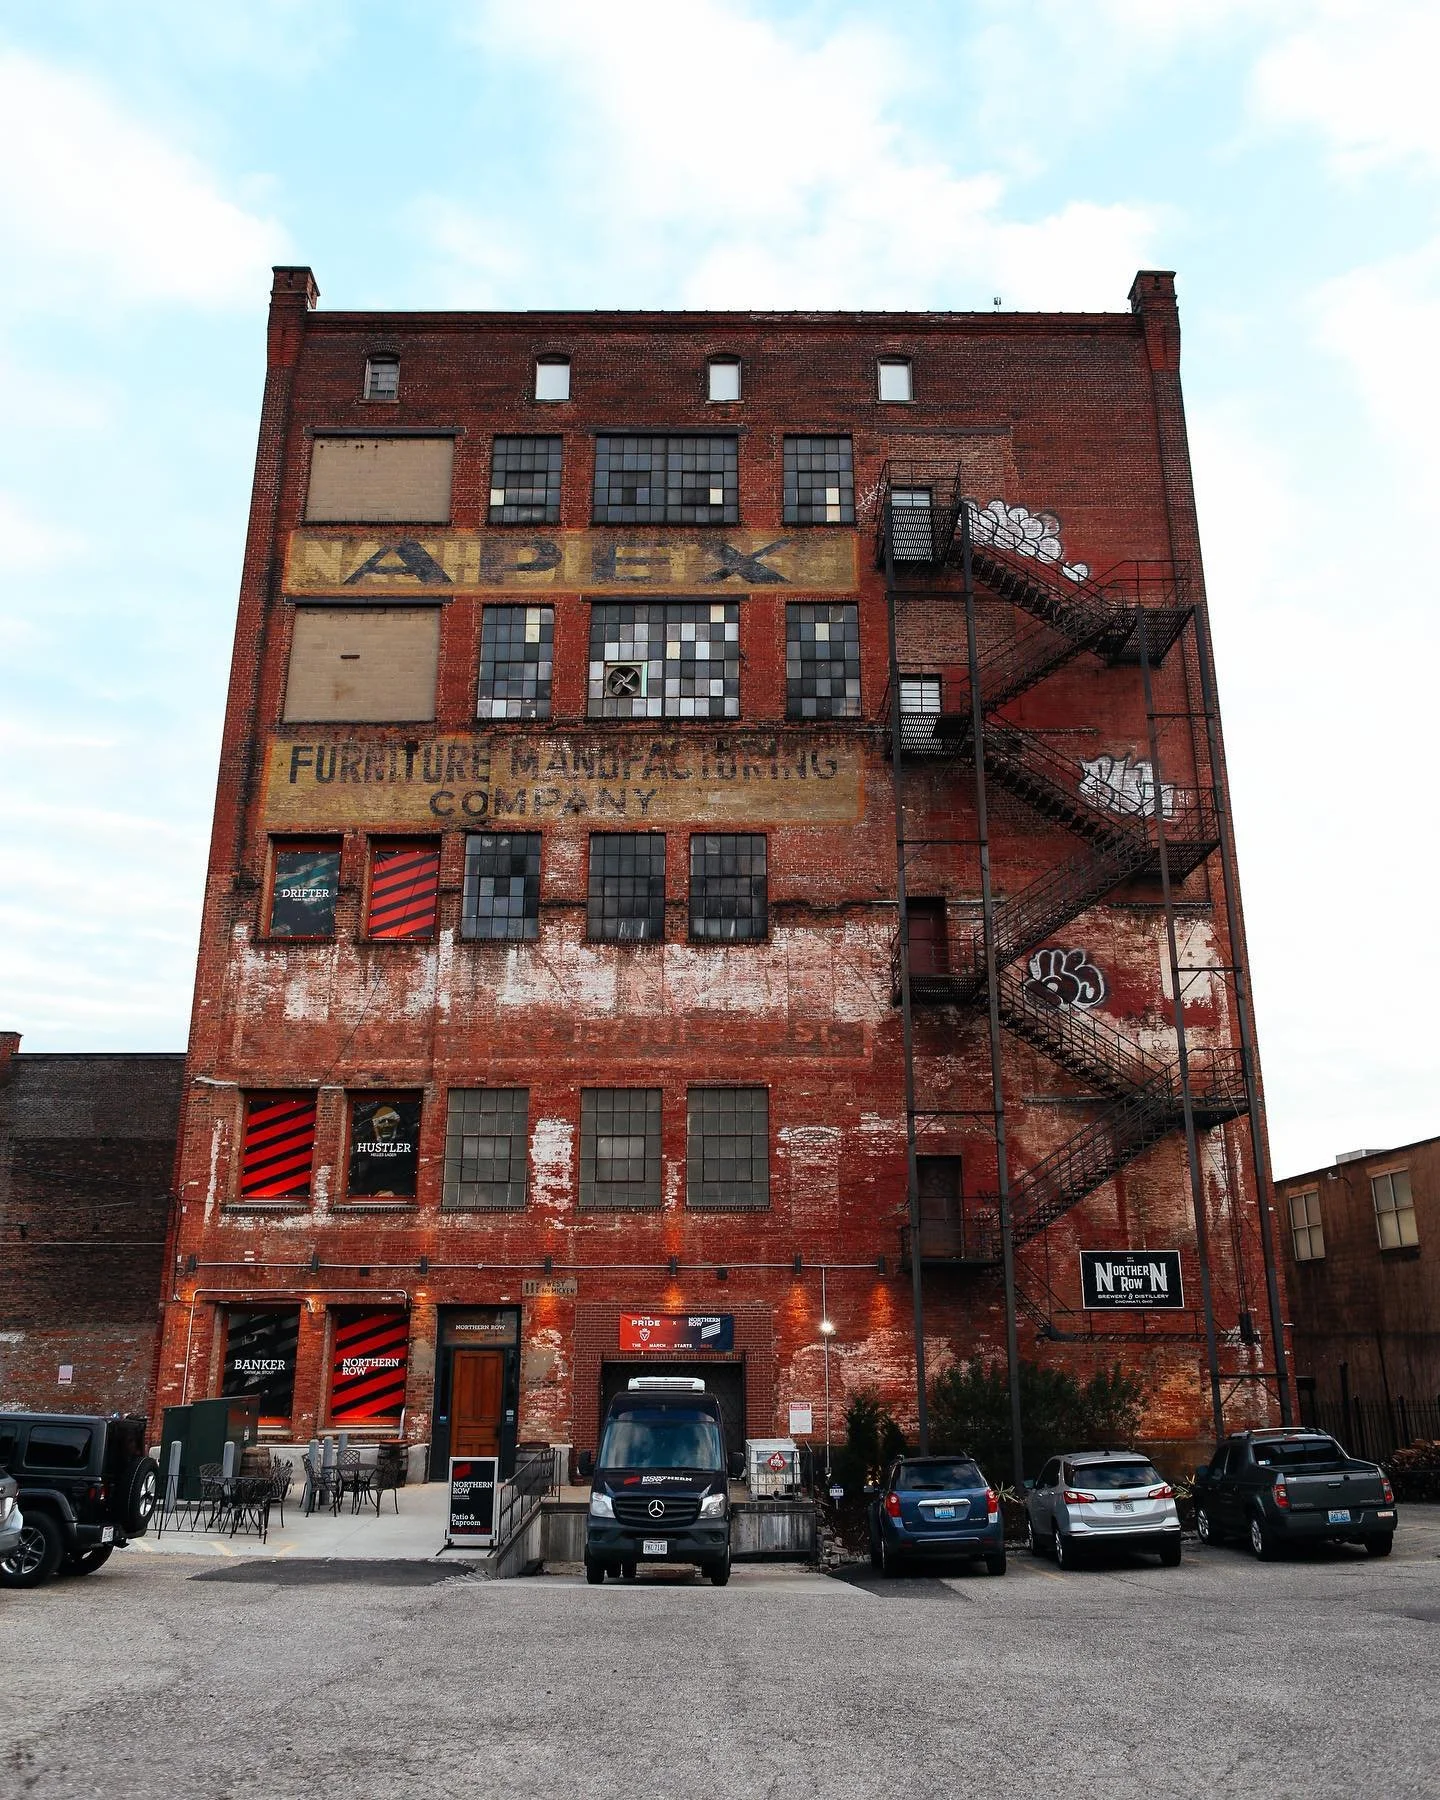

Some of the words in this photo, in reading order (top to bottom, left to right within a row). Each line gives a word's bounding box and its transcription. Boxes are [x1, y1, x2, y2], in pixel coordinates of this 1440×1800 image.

[289, 743, 491, 784] FURNITURE
[429, 788, 659, 817] COMPANY
[281, 888, 329, 898] DRIFTER
[357, 1142, 411, 1153] HUSTLER
[1094, 1262, 1168, 1292] NORTHERN
[547, 1280, 566, 1288] WEST
[1120, 1276, 1143, 1291] ROW
[631, 1319, 661, 1327] PRIDE
[234, 1359, 286, 1370] BANKER
[342, 1358, 400, 1367] NORTHERN
[342, 1367, 367, 1376] ROW
[451, 1519, 481, 1527] Taproom
